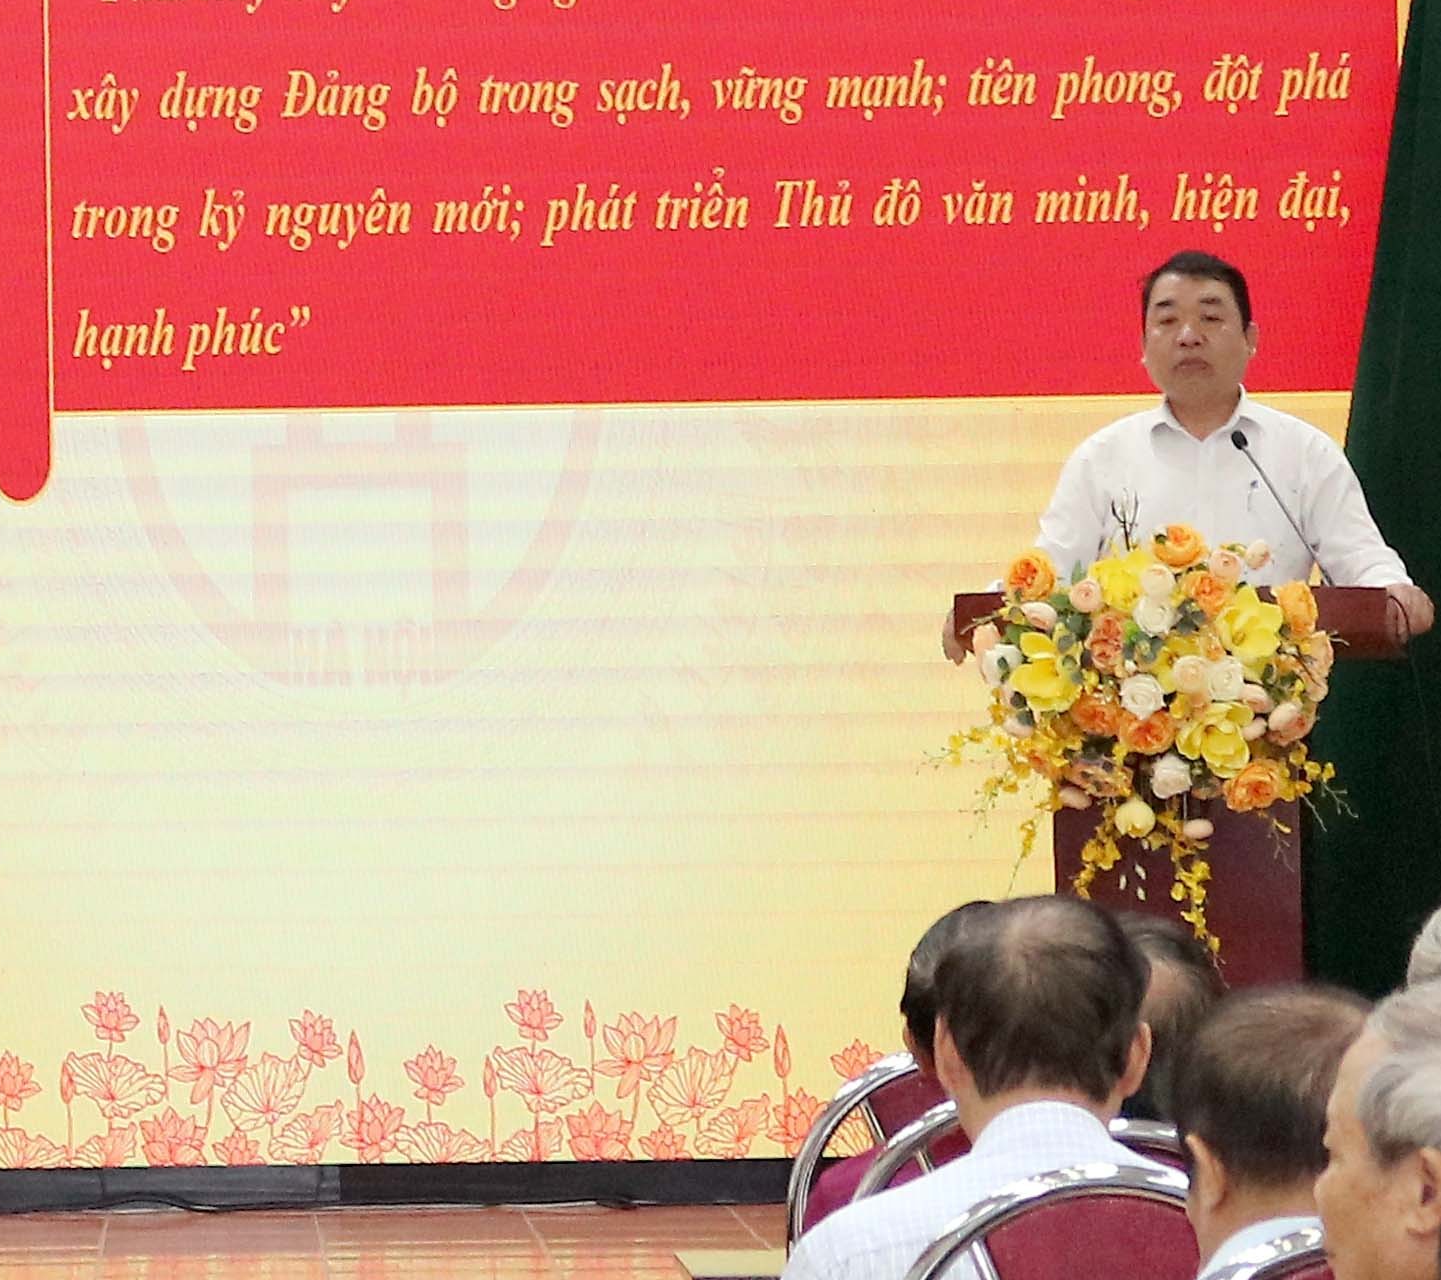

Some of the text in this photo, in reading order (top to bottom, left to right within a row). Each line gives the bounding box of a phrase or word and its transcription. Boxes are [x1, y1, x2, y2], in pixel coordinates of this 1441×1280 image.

[67, 52, 1350, 134] xây dựng Đảng bộ trong sạch, vững mạnh; tiên phong, đột phá
[72, 167, 1349, 252] trong kỷ nguyên mới; phát triển Thủ đô văn minh, hiện đại,
[74, 306, 310, 370] hạnh phúc”
